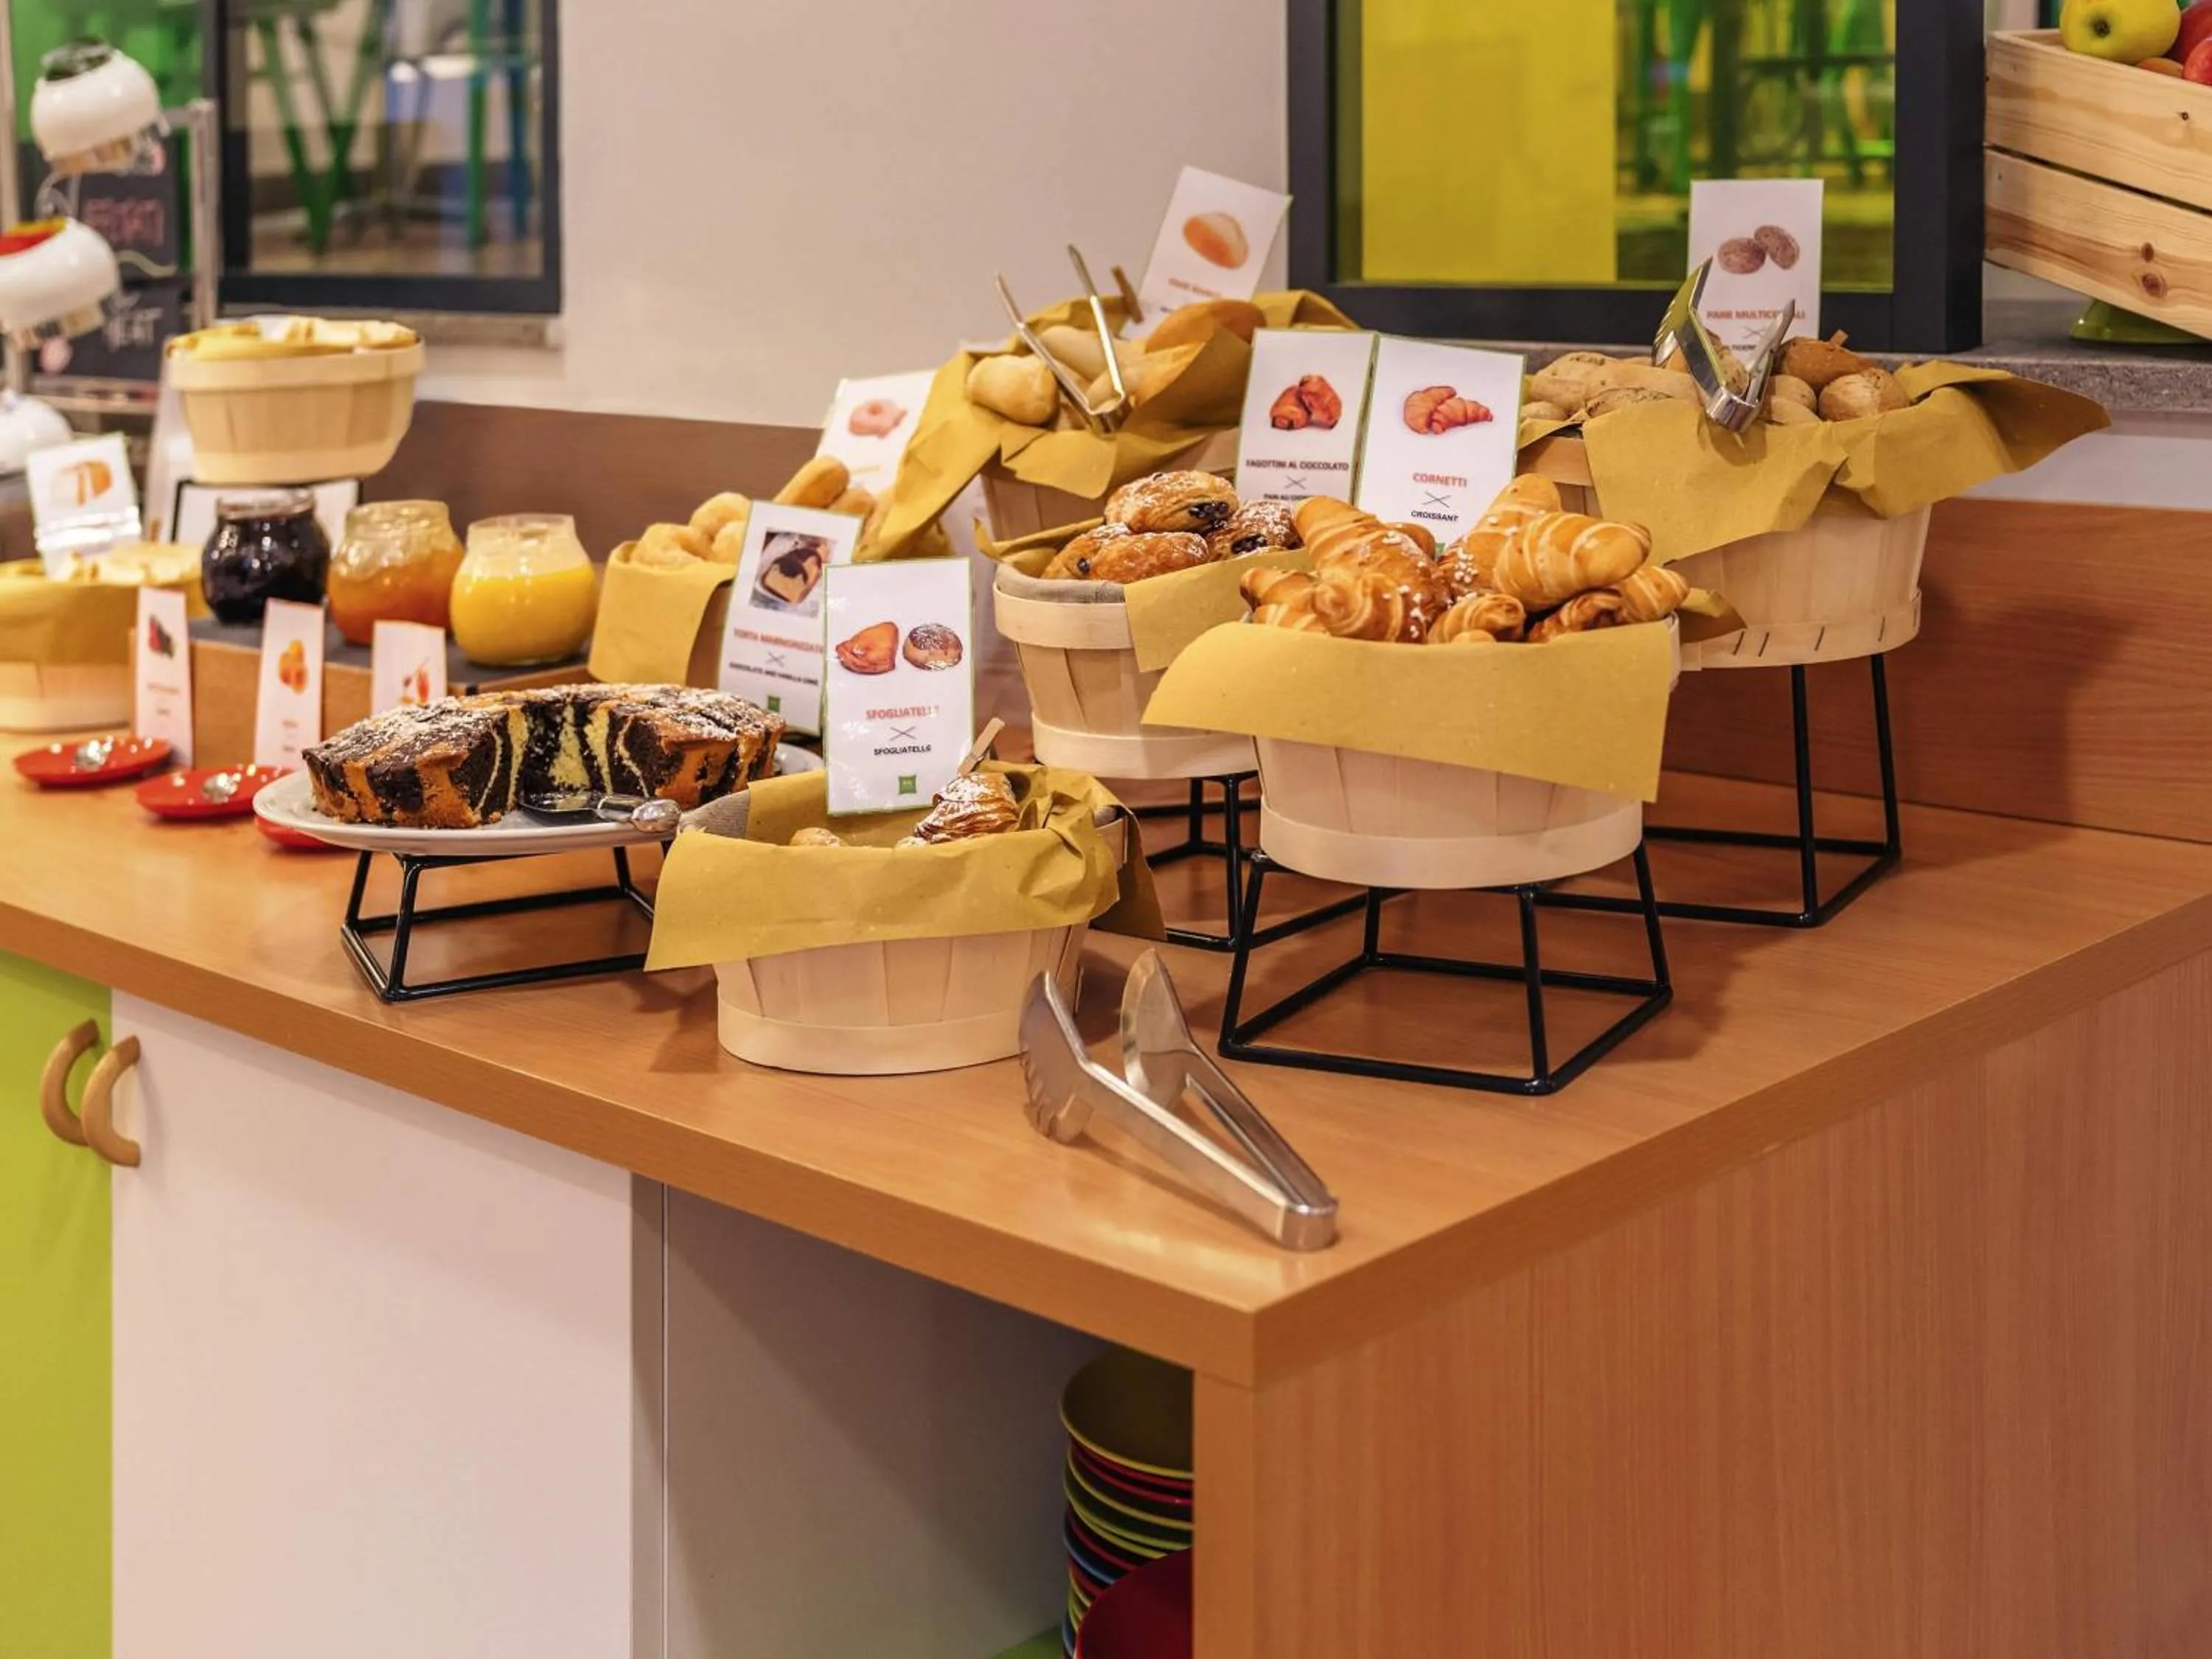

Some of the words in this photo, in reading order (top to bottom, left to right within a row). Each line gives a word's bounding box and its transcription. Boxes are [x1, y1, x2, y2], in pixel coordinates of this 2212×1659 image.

[1299, 461, 1349, 470] CIOCCOLATO
[1413, 473, 1467, 487] CORNETTI
[1411, 509, 1459, 521] CROISSANT
[874, 744, 931, 756] SFOGLIATELLE
